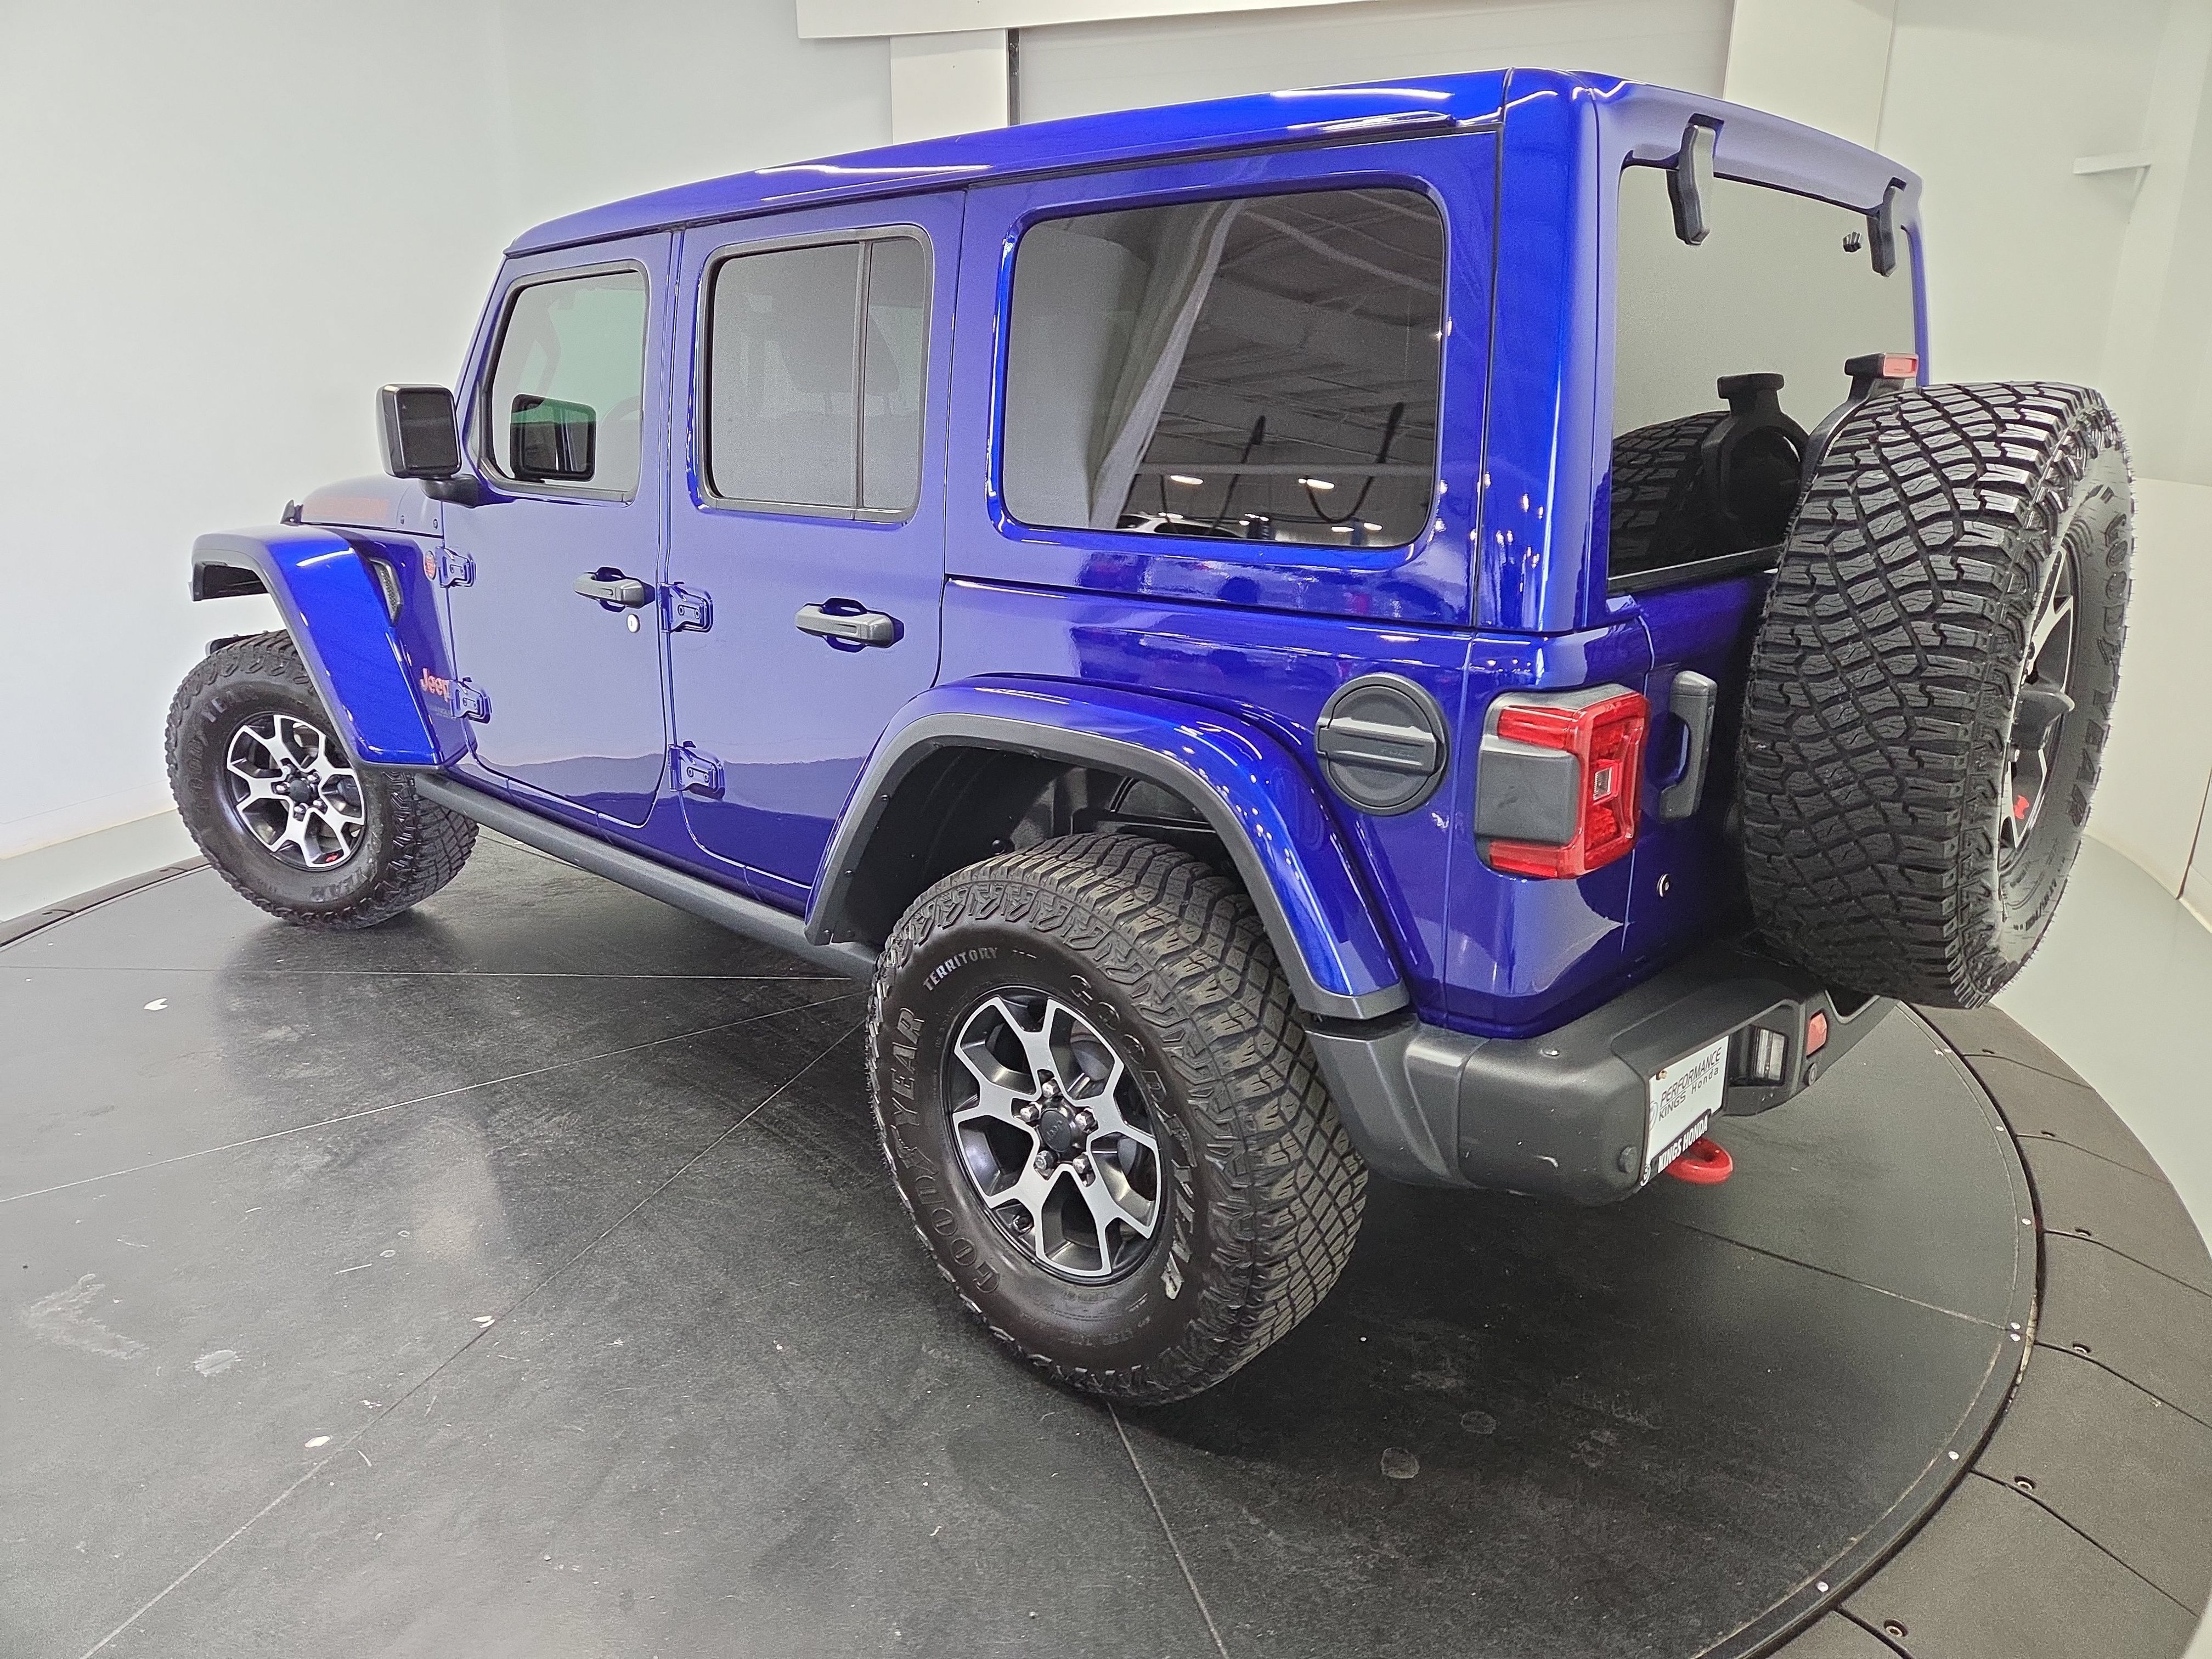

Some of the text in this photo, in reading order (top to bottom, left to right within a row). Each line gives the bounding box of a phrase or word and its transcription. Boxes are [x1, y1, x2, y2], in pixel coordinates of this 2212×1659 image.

[419, 667, 449, 702] Jeep
[922, 947, 998, 991] TERRITORY
[1658, 1067, 1719, 1121] KINGS Honda
[1660, 1047, 1722, 1108] PERFORMANCE
[1657, 1115, 1708, 1174] KINGS HONDA
